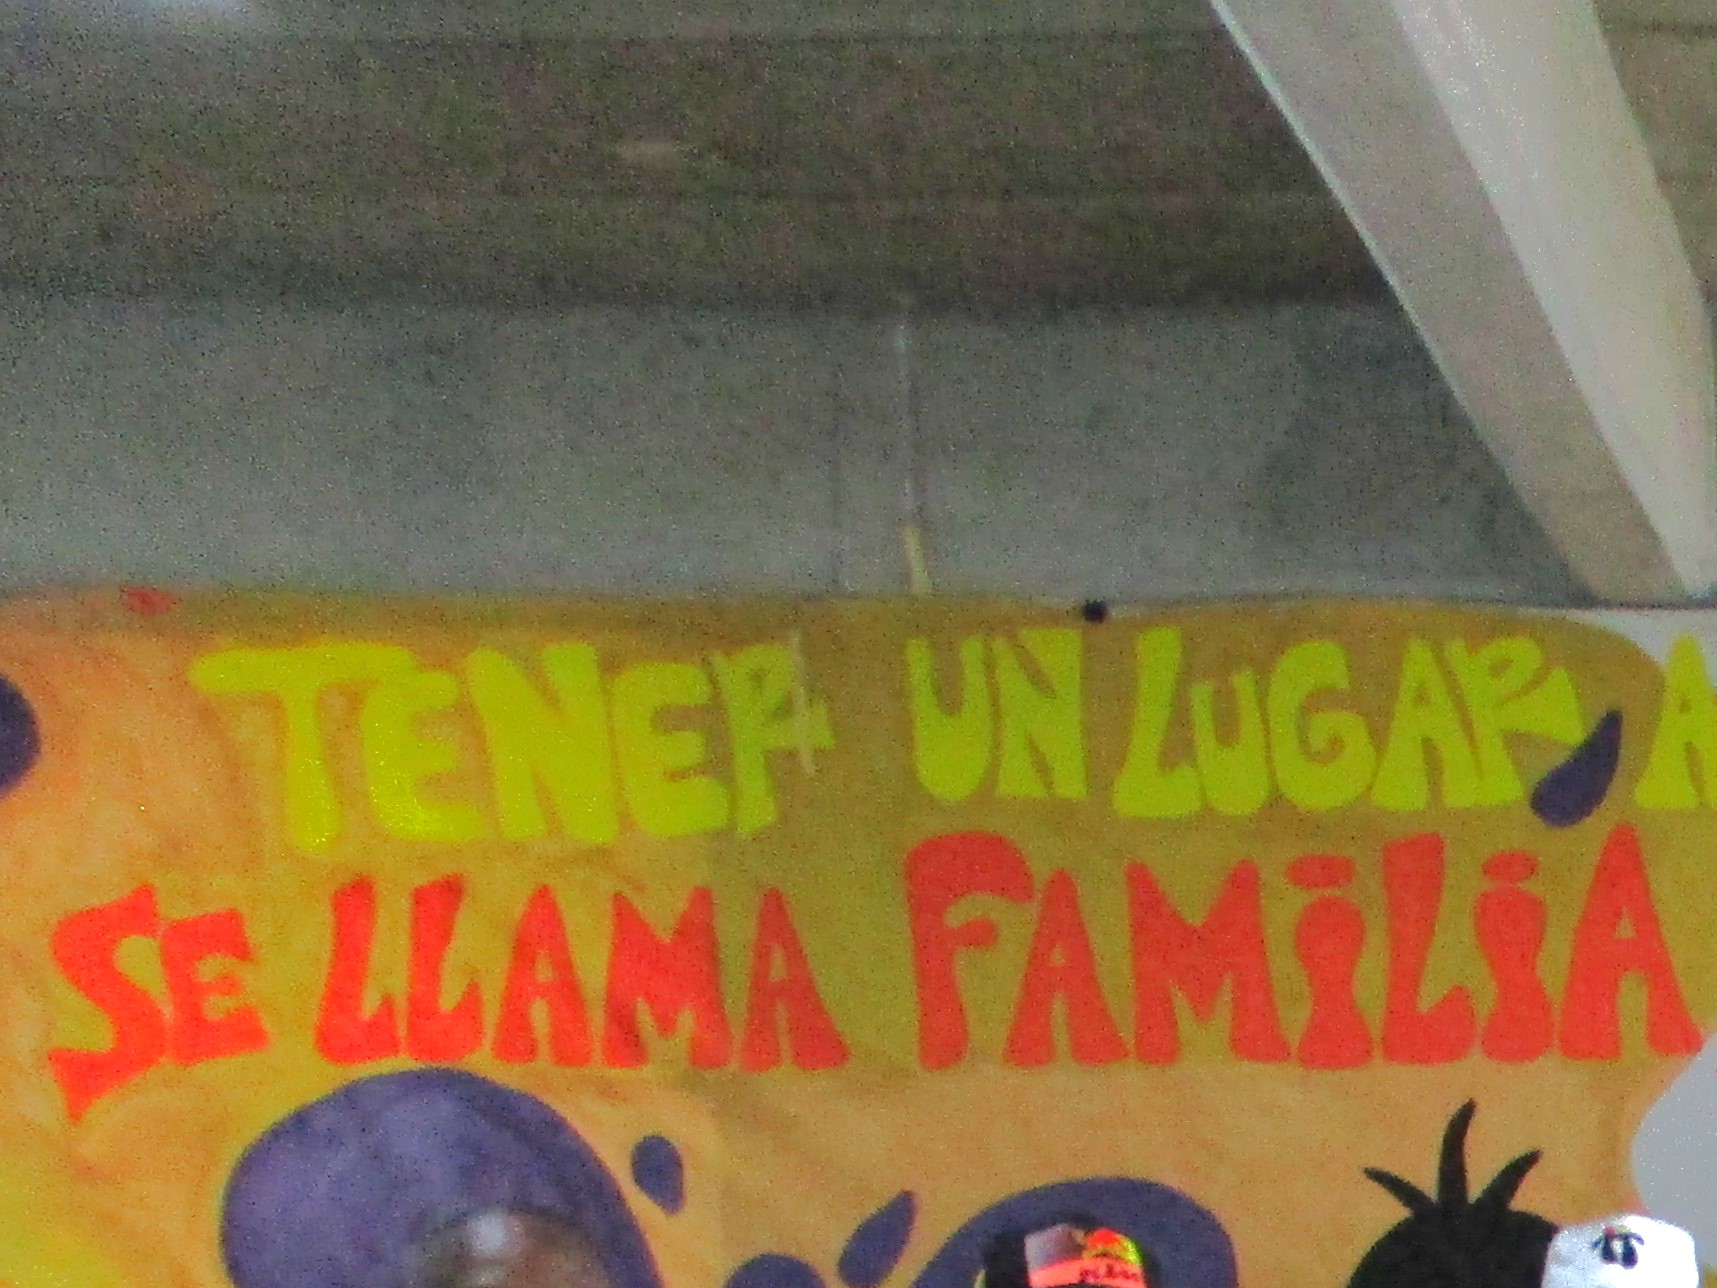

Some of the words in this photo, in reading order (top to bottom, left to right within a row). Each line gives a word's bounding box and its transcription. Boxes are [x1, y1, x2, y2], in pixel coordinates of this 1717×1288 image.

[189, 639, 835, 855] TENER
[904, 627, 1085, 804] UN
[1112, 627, 1585, 818] LUGAR
[48, 882, 270, 1124] SE
[314, 873, 849, 1073] LLAMA
